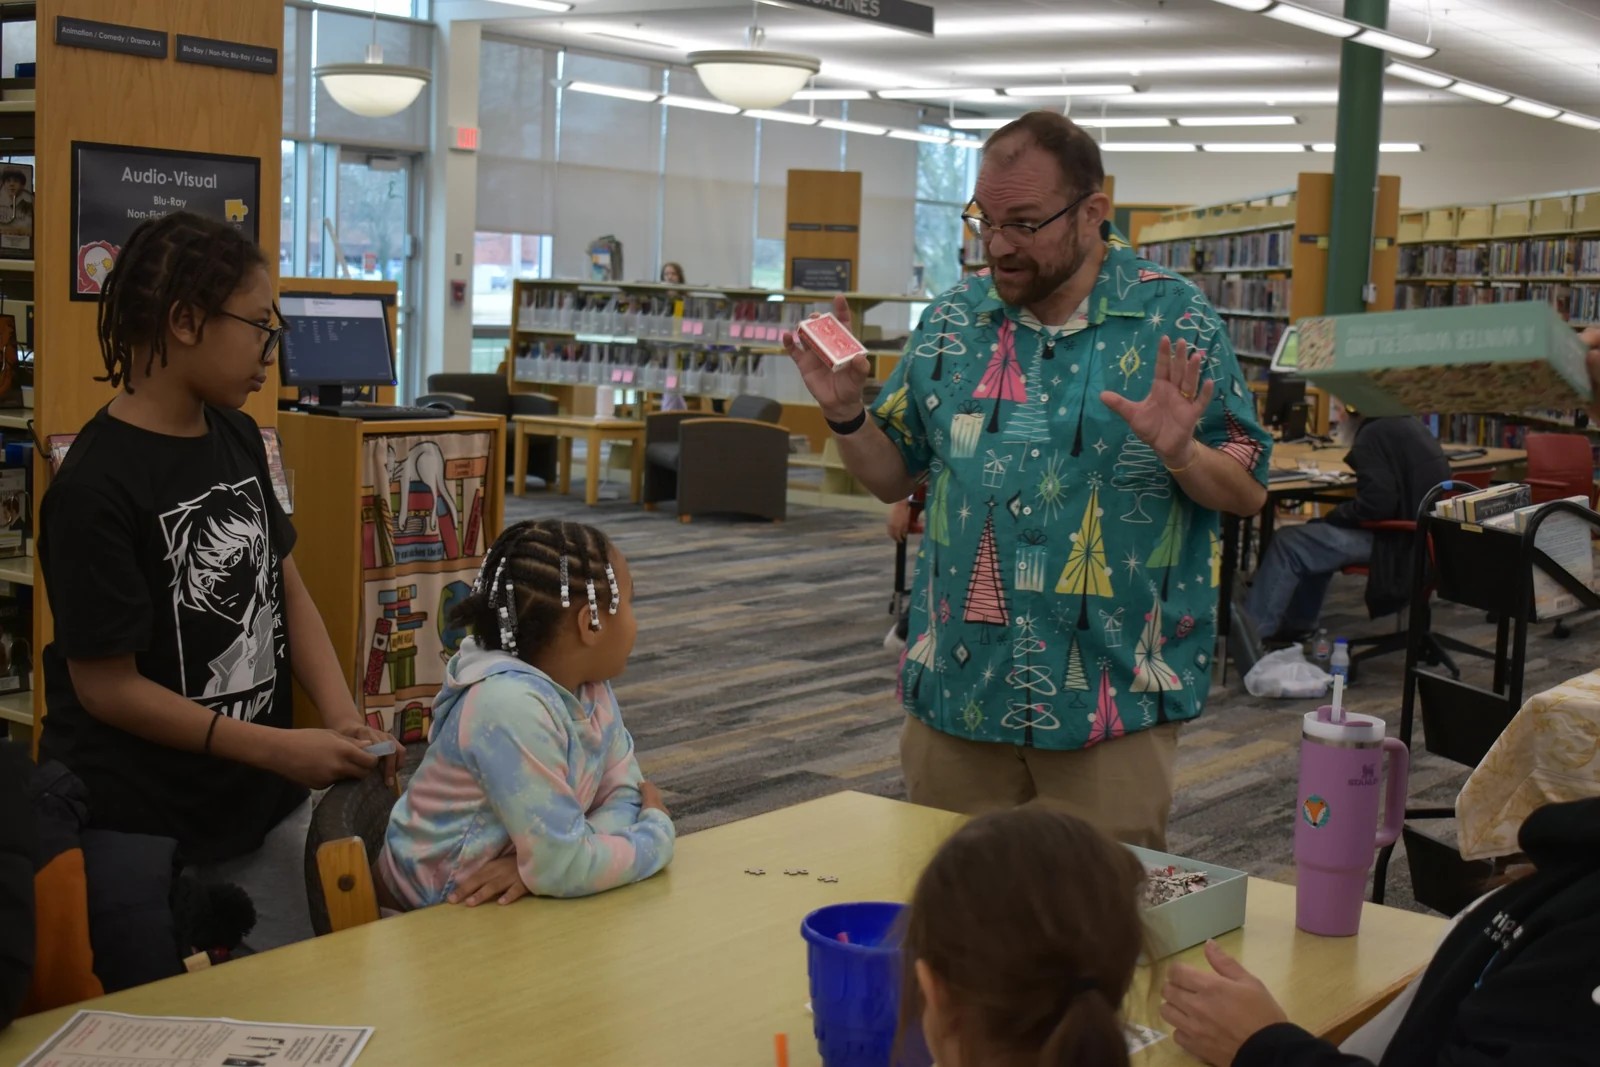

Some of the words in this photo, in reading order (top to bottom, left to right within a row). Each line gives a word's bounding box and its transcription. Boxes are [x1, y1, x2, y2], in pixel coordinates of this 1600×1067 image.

[61, 26, 93, 38] Animation
[98, 32, 125, 43] Comedy
[130, 36, 151, 46] Drama
[183, 45, 204, 55] Blu-Ray
[209, 49, 229, 58] Non-Fic
[230, 52, 251, 62] Blu-Ray
[255, 55, 273, 64] Action
[121, 166, 217, 189] Audio-Visual
[153, 196, 187, 208] Blu-Ray
